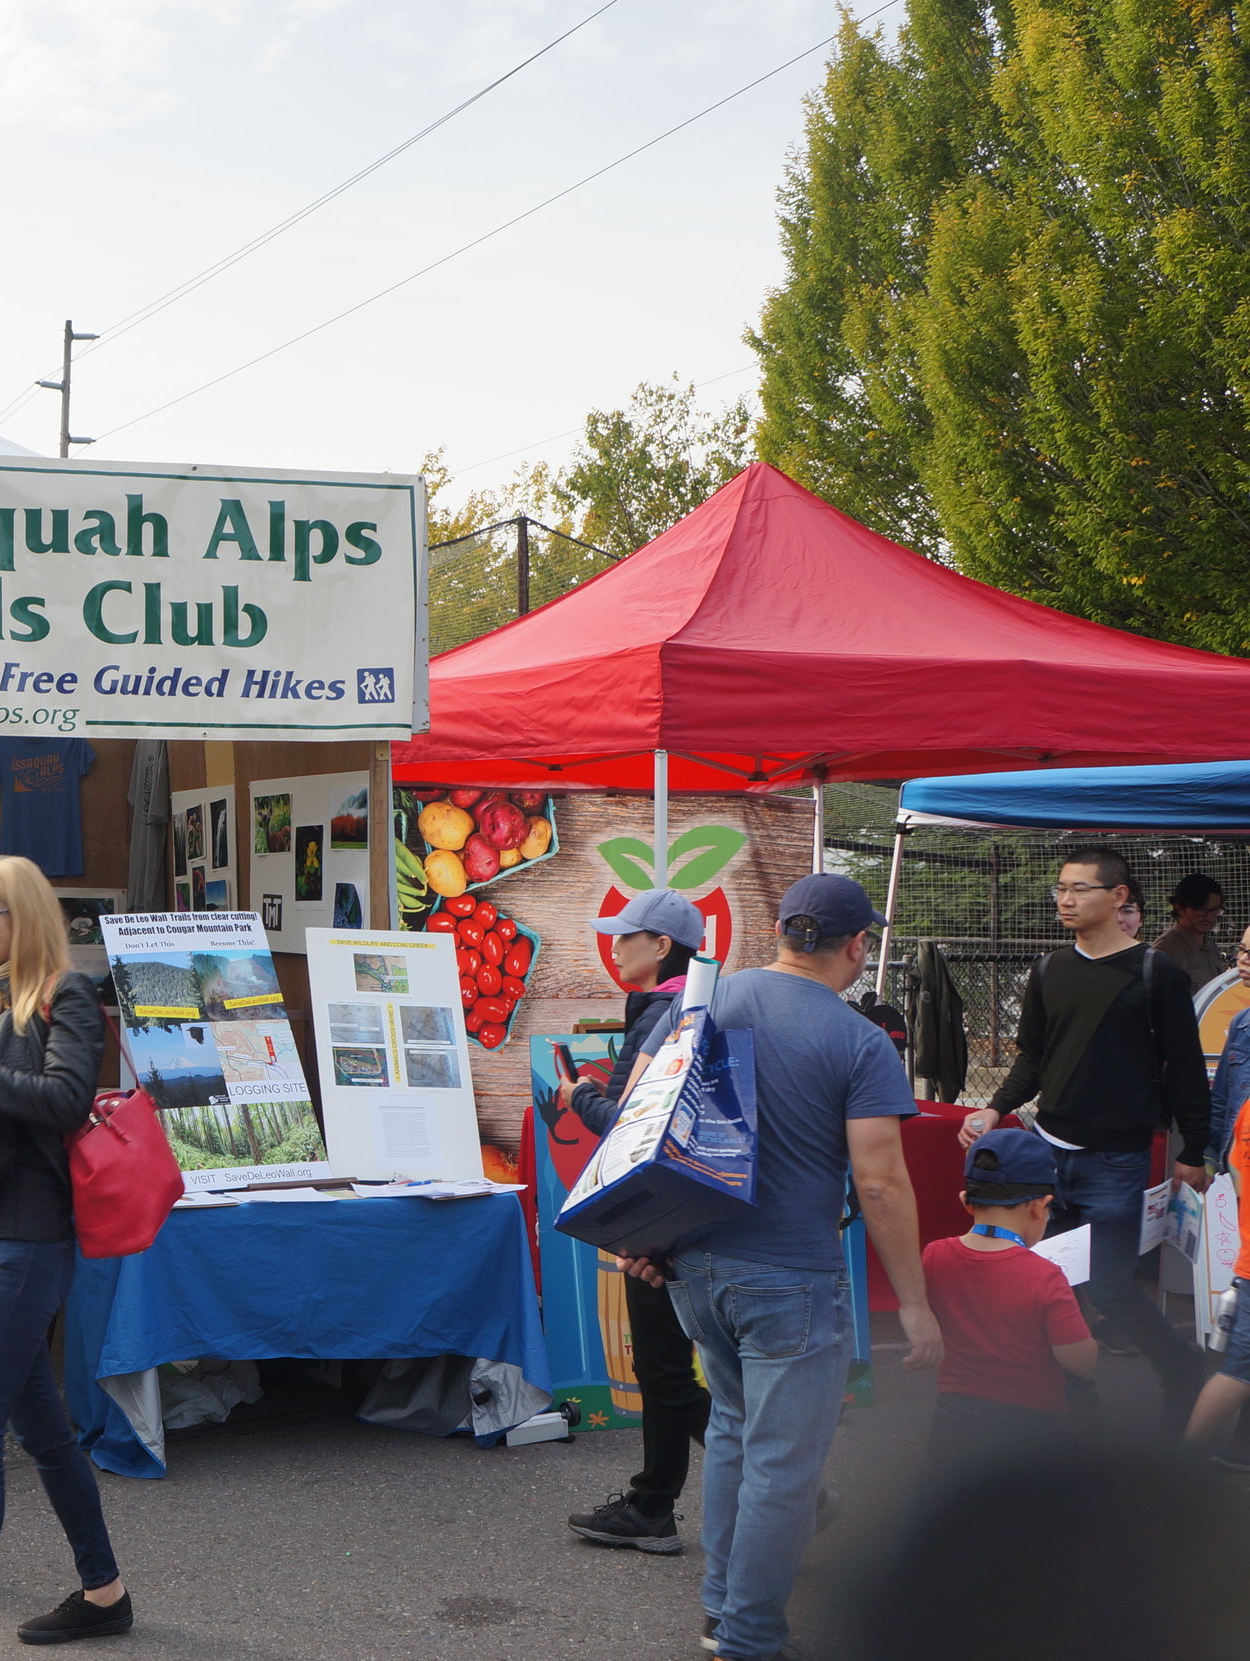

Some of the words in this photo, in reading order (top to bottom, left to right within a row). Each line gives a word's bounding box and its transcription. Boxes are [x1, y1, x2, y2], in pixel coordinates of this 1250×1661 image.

[202, 498, 383, 582] Alps
[82, 579, 268, 648] Club
[94, 664, 231, 698] Guided
[240, 669, 346, 701] Hikes
[12, 754, 60, 771] ISSAQUAH
[40, 764, 64, 776] ALPS
[104, 915, 124, 925] Save
[124, 915, 135, 924] De
[136, 914, 150, 923] Leo
[150, 913, 168, 923] Wall
[169, 913, 192, 922] Trails
[192, 912, 210, 921] from
[211, 912, 229, 921] clear
[230, 911, 258, 921] cutting!
[118, 925, 156, 937] Adjacent
[156, 925, 166, 935] to
[166, 924, 195, 935] Cougar
[196, 923, 234, 933] Mountain
[235, 922, 253, 932] Park
[228, 1083, 281, 1097] LOGGING
[282, 1082, 308, 1093] SITE
[189, 1174, 217, 1185] VISIT
[224, 1168, 312, 1183] SaveDeLeoWall.org
